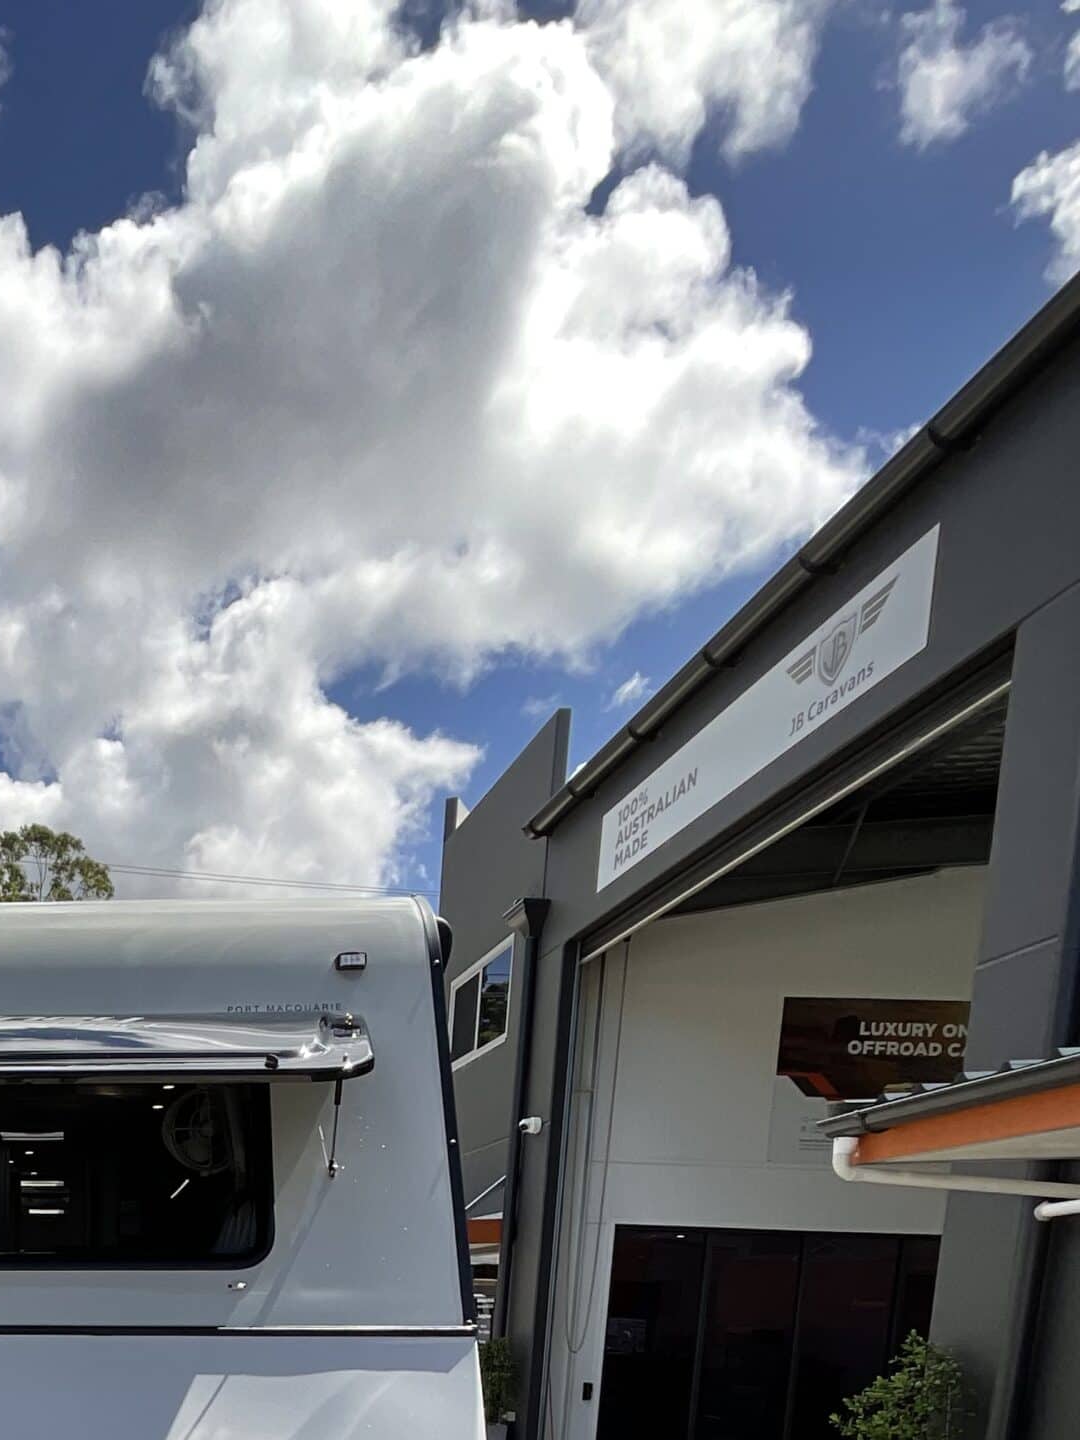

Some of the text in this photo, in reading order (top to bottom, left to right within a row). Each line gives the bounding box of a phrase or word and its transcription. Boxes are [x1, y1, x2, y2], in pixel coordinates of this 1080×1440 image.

[789, 660, 874, 737] JB Caravans
[615, 767, 699, 849] AUSTRALIAN
[617, 787, 649, 827] 100%
[613, 829, 649, 870] MADE
[847, 1040, 942, 1056] OFFROAD
[859, 1021, 938, 1037] LUXURY
